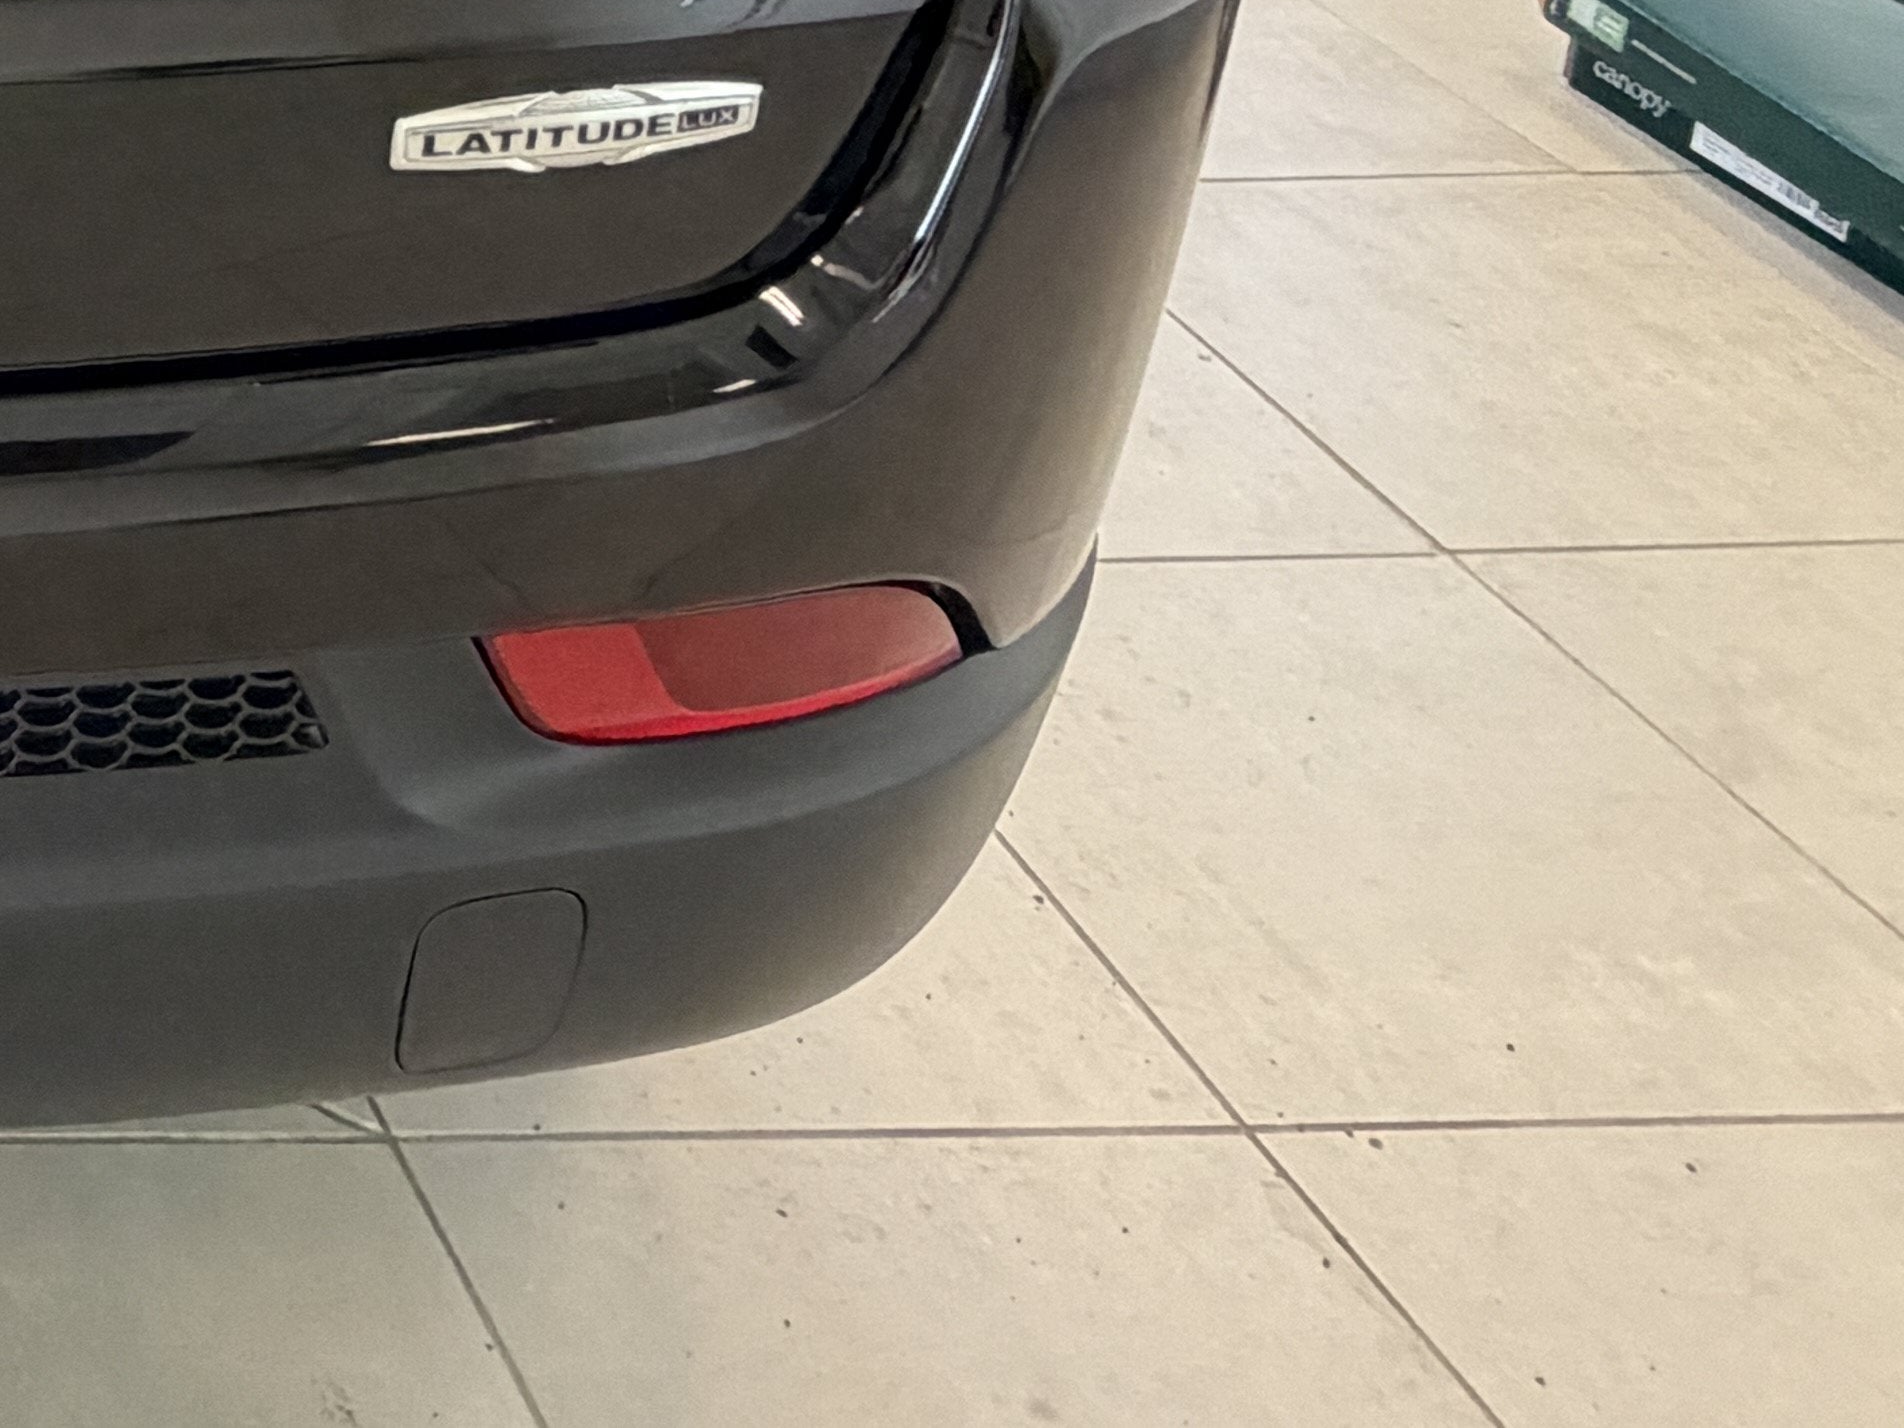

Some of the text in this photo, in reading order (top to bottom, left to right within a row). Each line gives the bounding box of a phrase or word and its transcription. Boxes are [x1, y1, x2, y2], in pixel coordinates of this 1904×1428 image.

[1592, 60, 1672, 118] canopy
[421, 105, 739, 158] LATITUDE LUX
